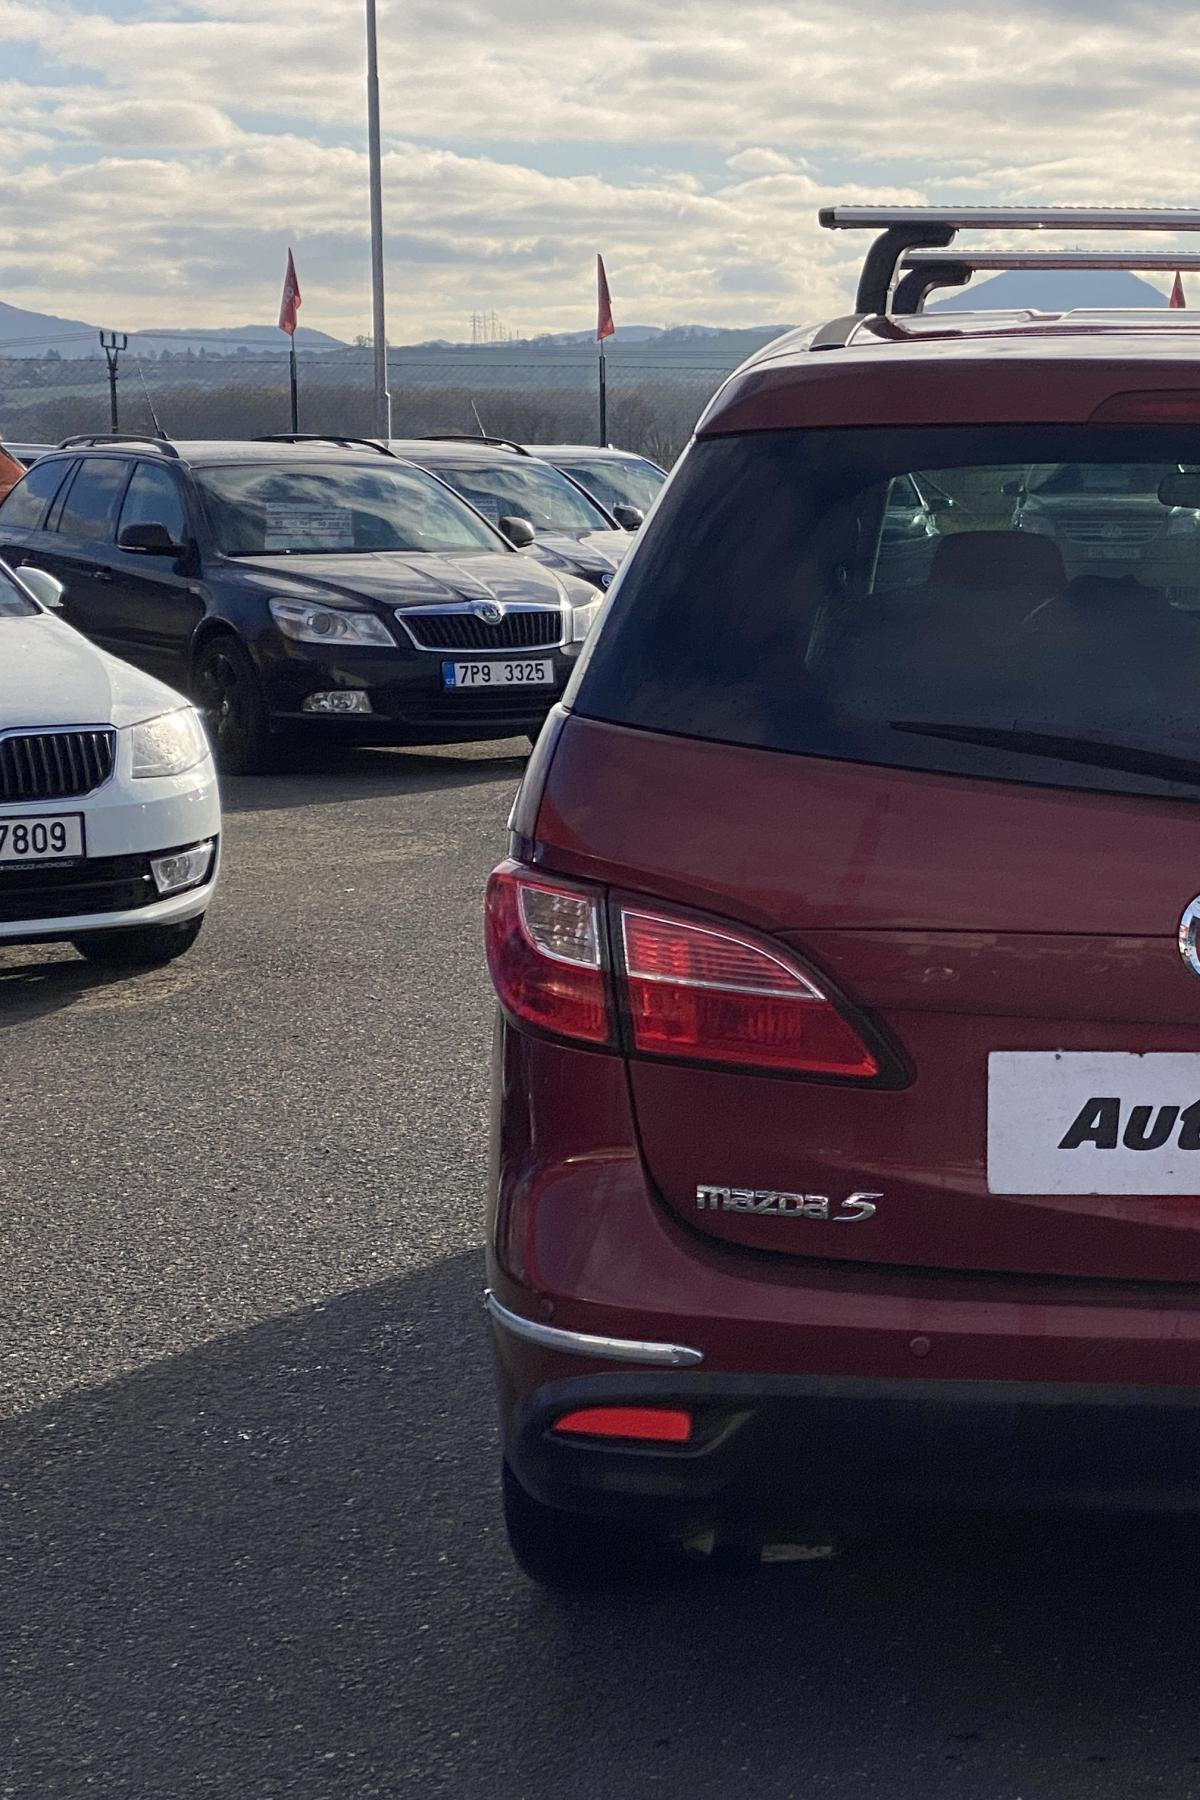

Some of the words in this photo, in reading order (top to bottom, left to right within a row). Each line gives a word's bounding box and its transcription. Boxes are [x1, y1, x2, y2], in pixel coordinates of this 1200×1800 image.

[459, 665, 491, 684] 7P9
[504, 663, 545, 682] 3325
[832, 1192, 884, 1222] 5
